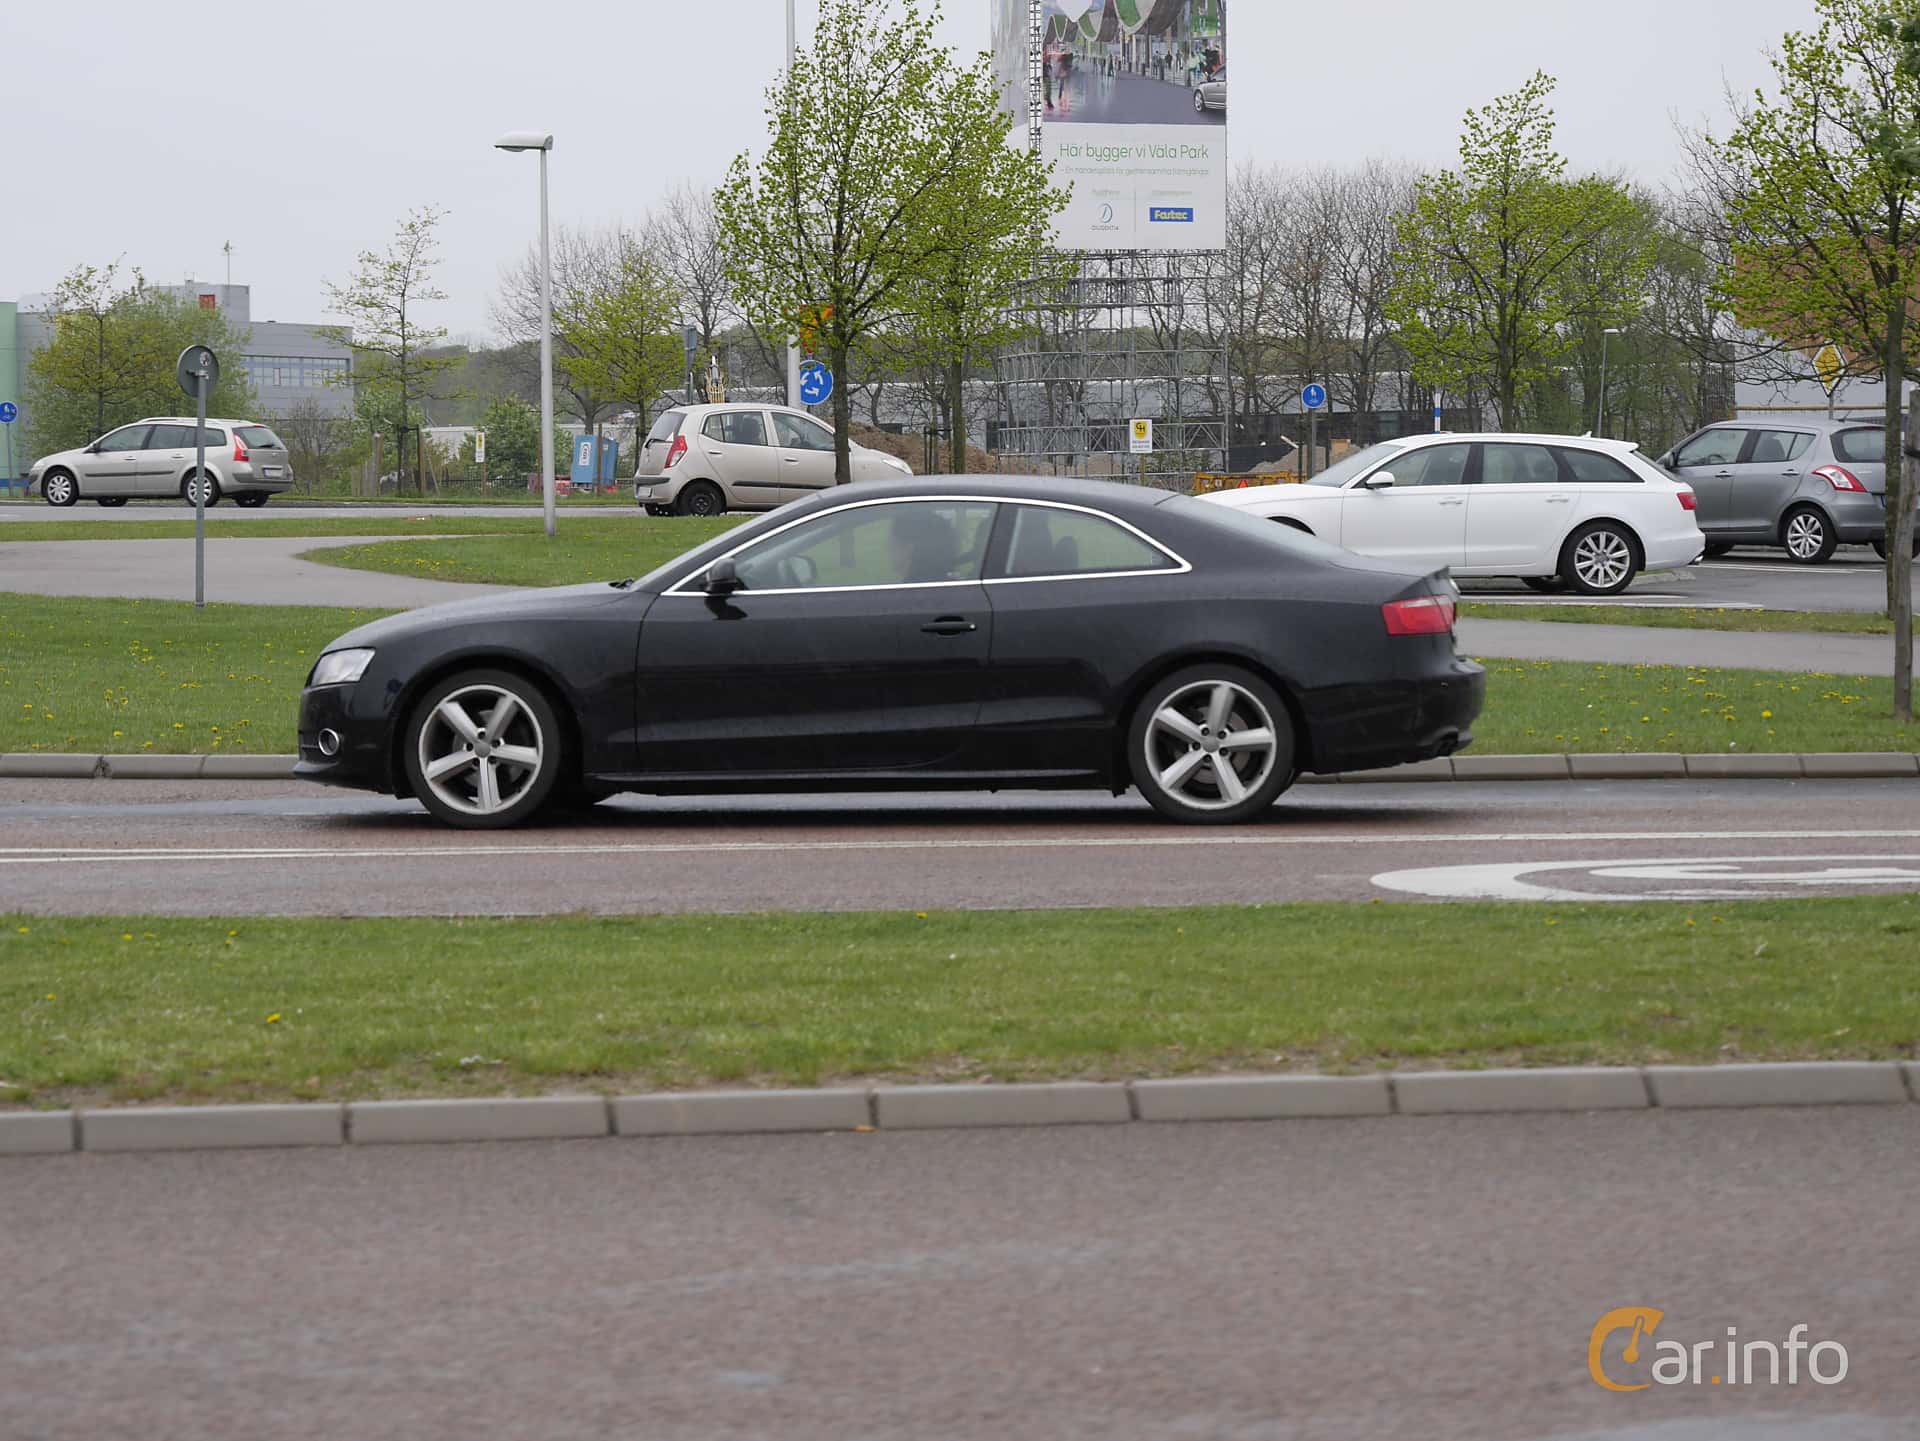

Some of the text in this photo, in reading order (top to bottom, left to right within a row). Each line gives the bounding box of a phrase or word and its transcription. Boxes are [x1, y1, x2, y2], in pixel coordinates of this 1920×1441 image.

[1060, 143, 1209, 162] Här bygger vi Väla Park
